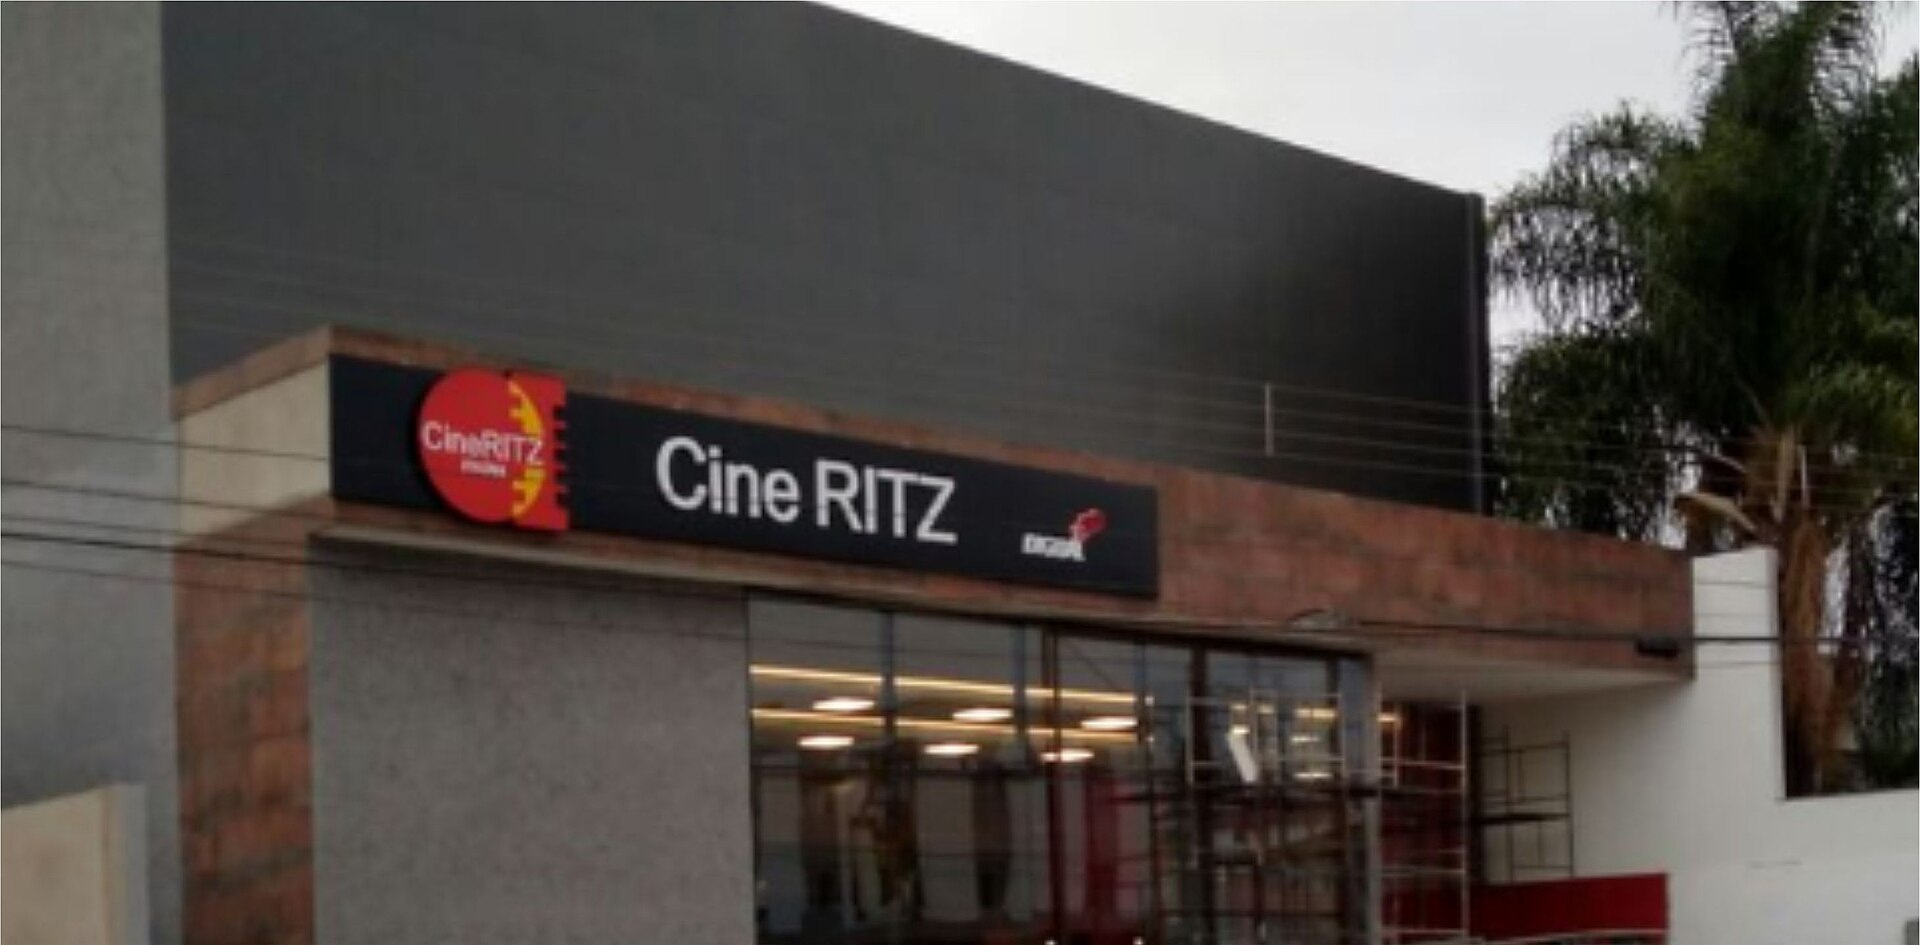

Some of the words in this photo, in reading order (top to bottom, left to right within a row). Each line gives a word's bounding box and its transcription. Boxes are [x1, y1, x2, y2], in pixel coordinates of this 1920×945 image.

[421, 420, 545, 466] CineRITZ
[656, 435, 800, 524] Cine
[815, 458, 957, 544] RITZ
